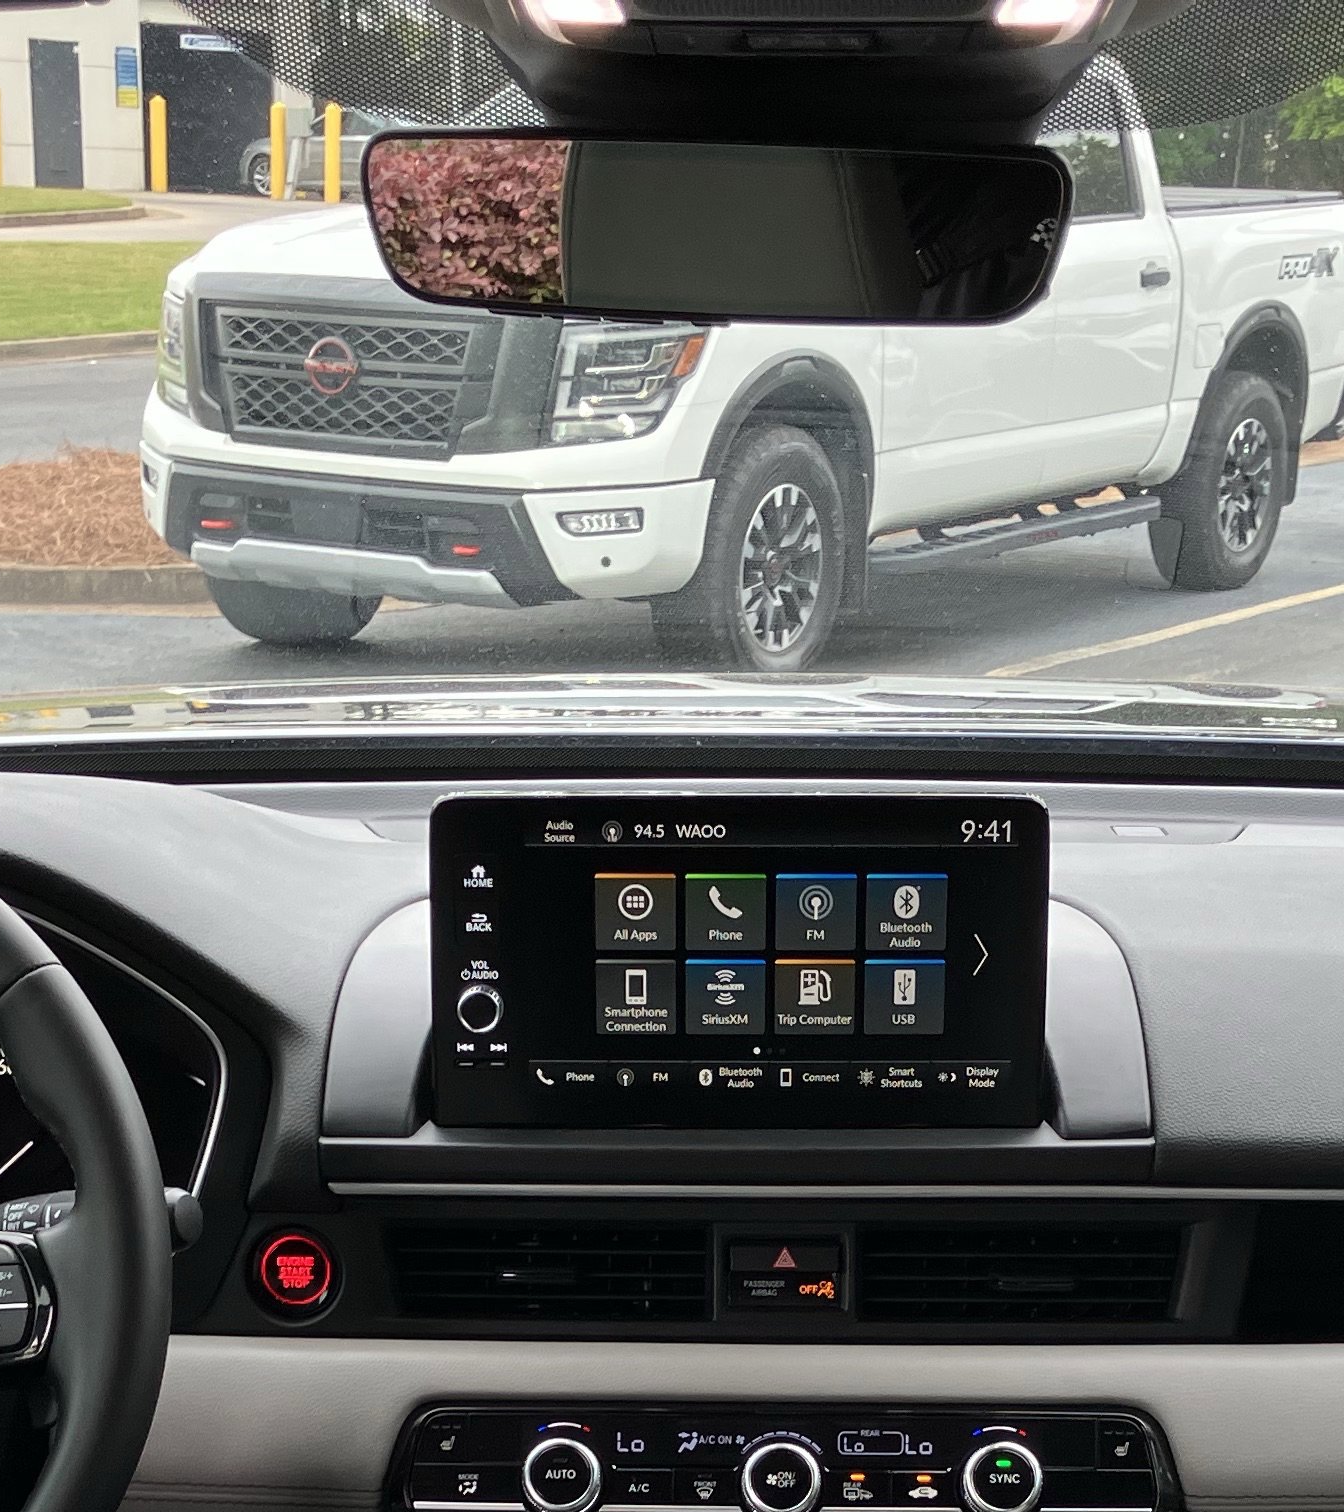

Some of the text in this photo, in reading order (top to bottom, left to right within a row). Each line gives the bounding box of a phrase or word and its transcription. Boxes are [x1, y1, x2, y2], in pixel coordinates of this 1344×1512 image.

[546, 821, 573, 830] Audio
[635, 824, 726, 838] 94.5 WAOO
[961, 820, 1011, 842] 9:41
[545, 833, 575, 842] Source
[464, 878, 493, 887] HOME
[466, 921, 492, 931] BACK
[880, 922, 932, 932] Bluetooth
[614, 929, 657, 941] All Apps
[709, 930, 742, 940] Phone
[807, 930, 824, 940] FM
[890, 937, 920, 947] Audio
[471, 960, 489, 969] VOL
[471, 971, 498, 979] AUDIO
[605, 1007, 667, 1018] Smartphone
[702, 1014, 748, 1024] SiriusXM
[778, 1014, 852, 1026] Trip Computer
[892, 1014, 915, 1024] USB
[606, 1021, 666, 1031] Connection
[719, 1067, 762, 1076] Bluetooth
[889, 1067, 914, 1076] Smart
[967, 1067, 999, 1077] Display
[566, 1072, 594, 1081] Phone
[653, 1073, 668, 1081] FM
[803, 1073, 839, 1082] Connect
[728, 1079, 754, 1088] Audio
[881, 1079, 922, 1088] Shortcuts
[969, 1078, 995, 1087] Mode
[277, 1256, 315, 1266] ENGINE
[280, 1267, 312, 1276] START
[282, 1279, 310, 1289] STOP
[743, 1280, 785, 1288] PASSENGER
[751, 1288, 778, 1297] AIRBAG
[799, 1284, 818, 1295] OFF
[617, 1432, 644, 1452] Lo
[699, 1435, 732, 1444] A/C ON
[844, 1437, 864, 1452] Lo
[905, 1435, 932, 1454] Lo
[546, 1470, 576, 1479] AUTO
[777, 1472, 795, 1480] ON/
[990, 1474, 1020, 1483] SYNC
[694, 1481, 716, 1489] FRONT
[778, 1478, 795, 1487] OFF
[629, 1484, 649, 1492] A/C
